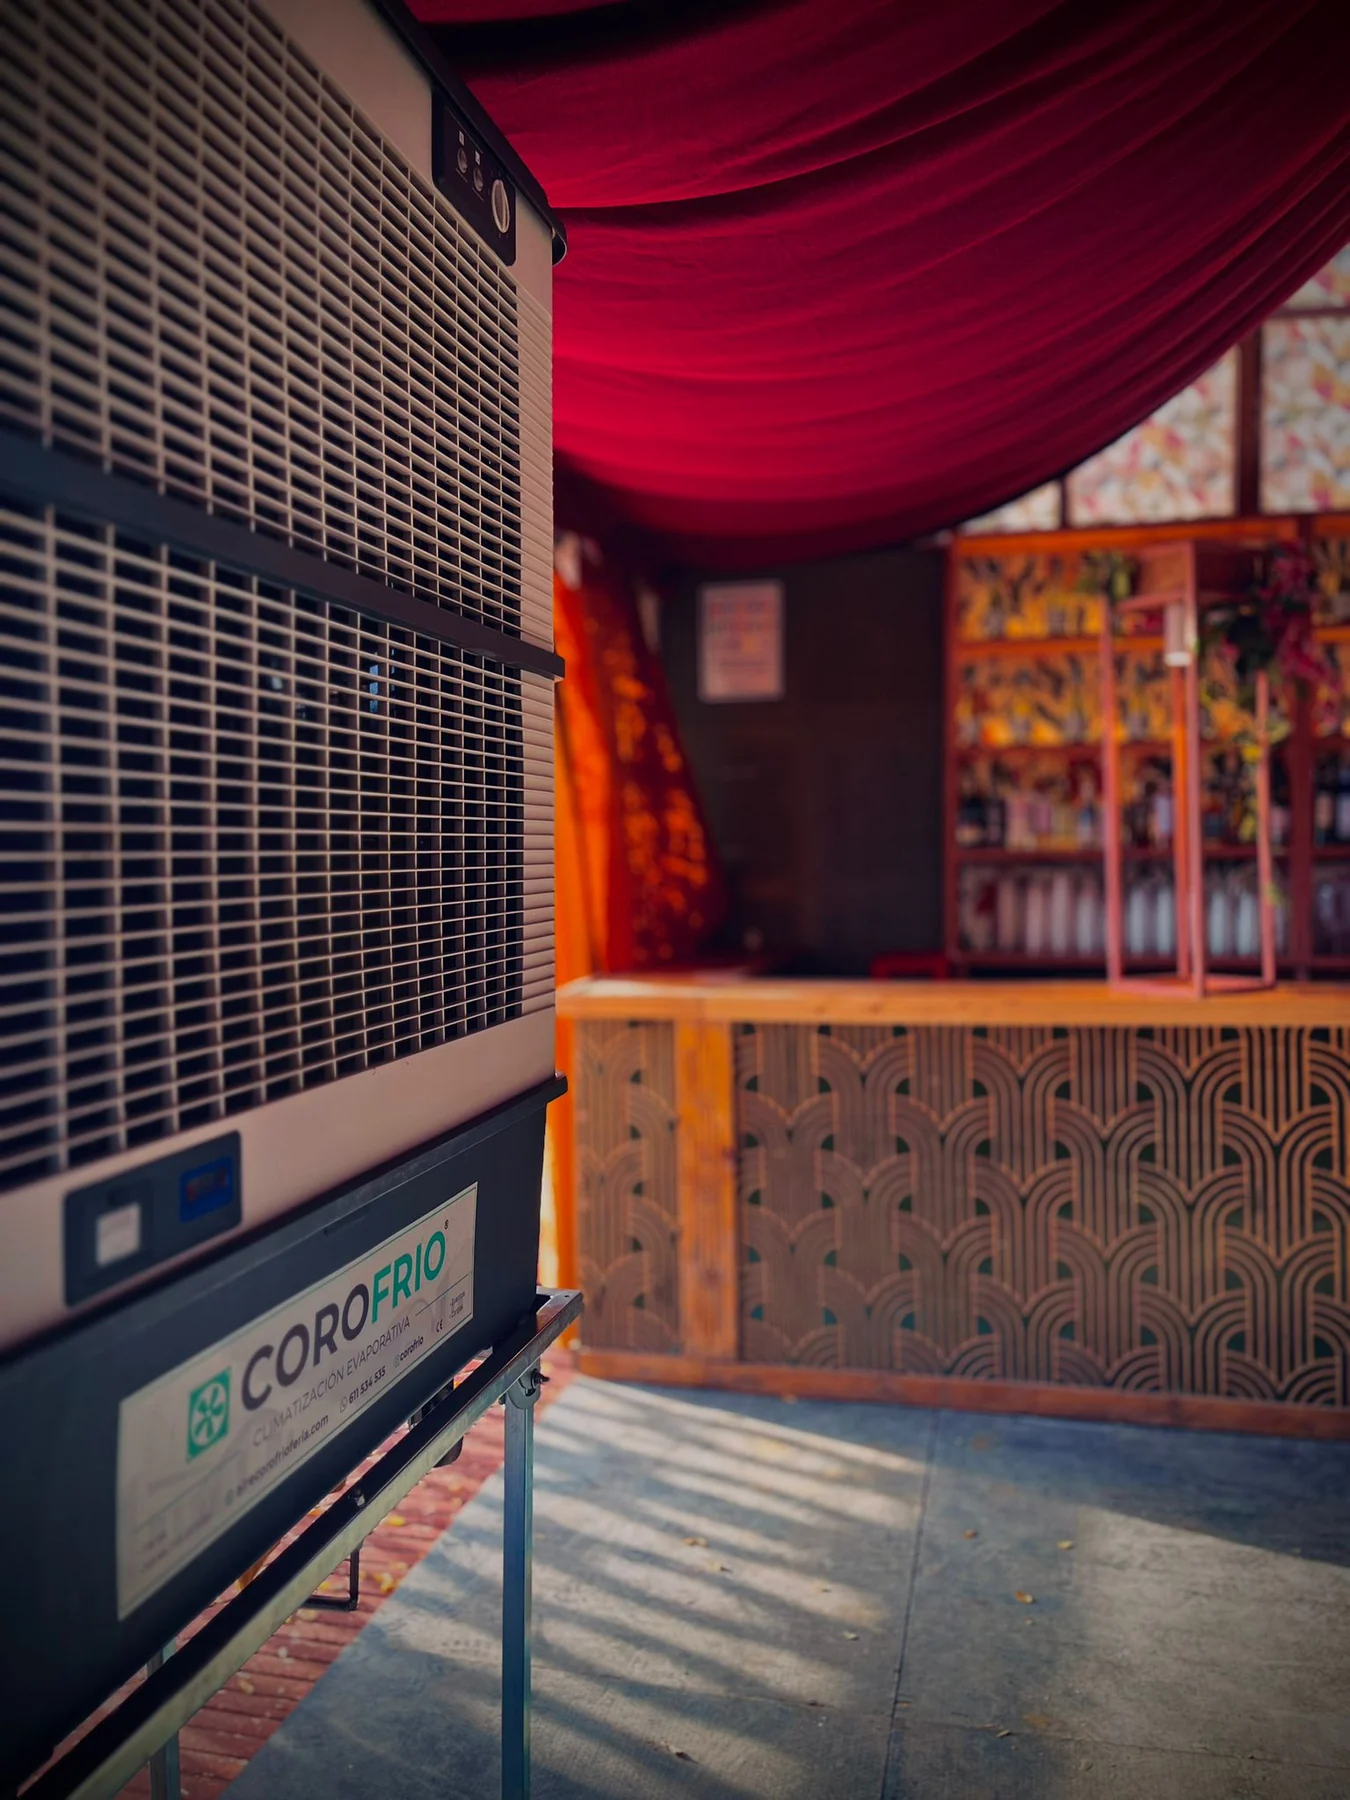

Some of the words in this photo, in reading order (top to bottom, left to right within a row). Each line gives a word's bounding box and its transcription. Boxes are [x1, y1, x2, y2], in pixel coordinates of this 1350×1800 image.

[241, 1230, 446, 1411] COROFRIO
[253, 1366, 344, 1447] CLIMATIZACIÓN
[347, 1316, 410, 1376] EVAPORATIVA
[349, 1391, 359, 1404] 611
[360, 1377, 373, 1395] 534
[374, 1365, 386, 1381] 535
